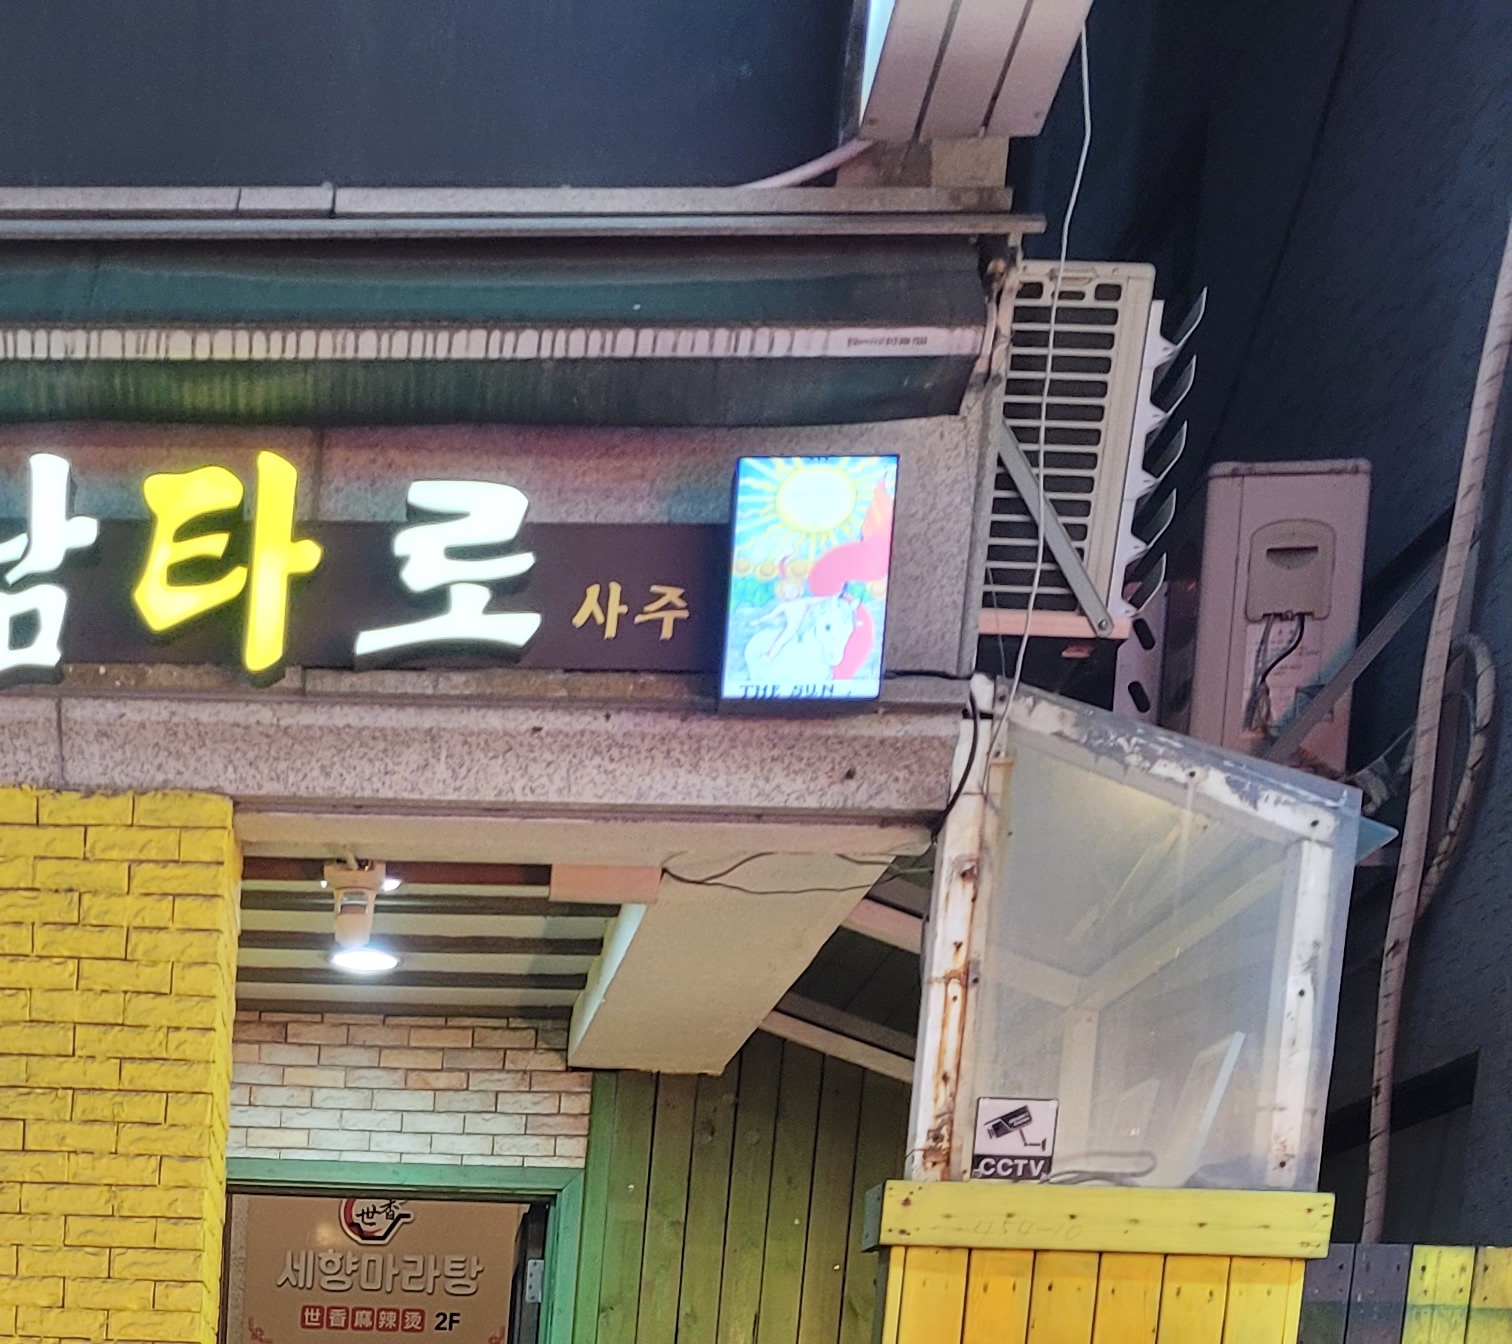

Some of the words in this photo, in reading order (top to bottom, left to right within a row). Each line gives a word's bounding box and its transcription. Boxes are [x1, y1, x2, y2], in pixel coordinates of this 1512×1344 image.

[572, 581, 689, 641] 사주
[978, 1157, 1046, 1177] CCTV
[974, 1219, 1084, 1244] 454-10
[277, 1249, 484, 1296] 세향마라탕
[434, 1312, 461, 1332] 2F
